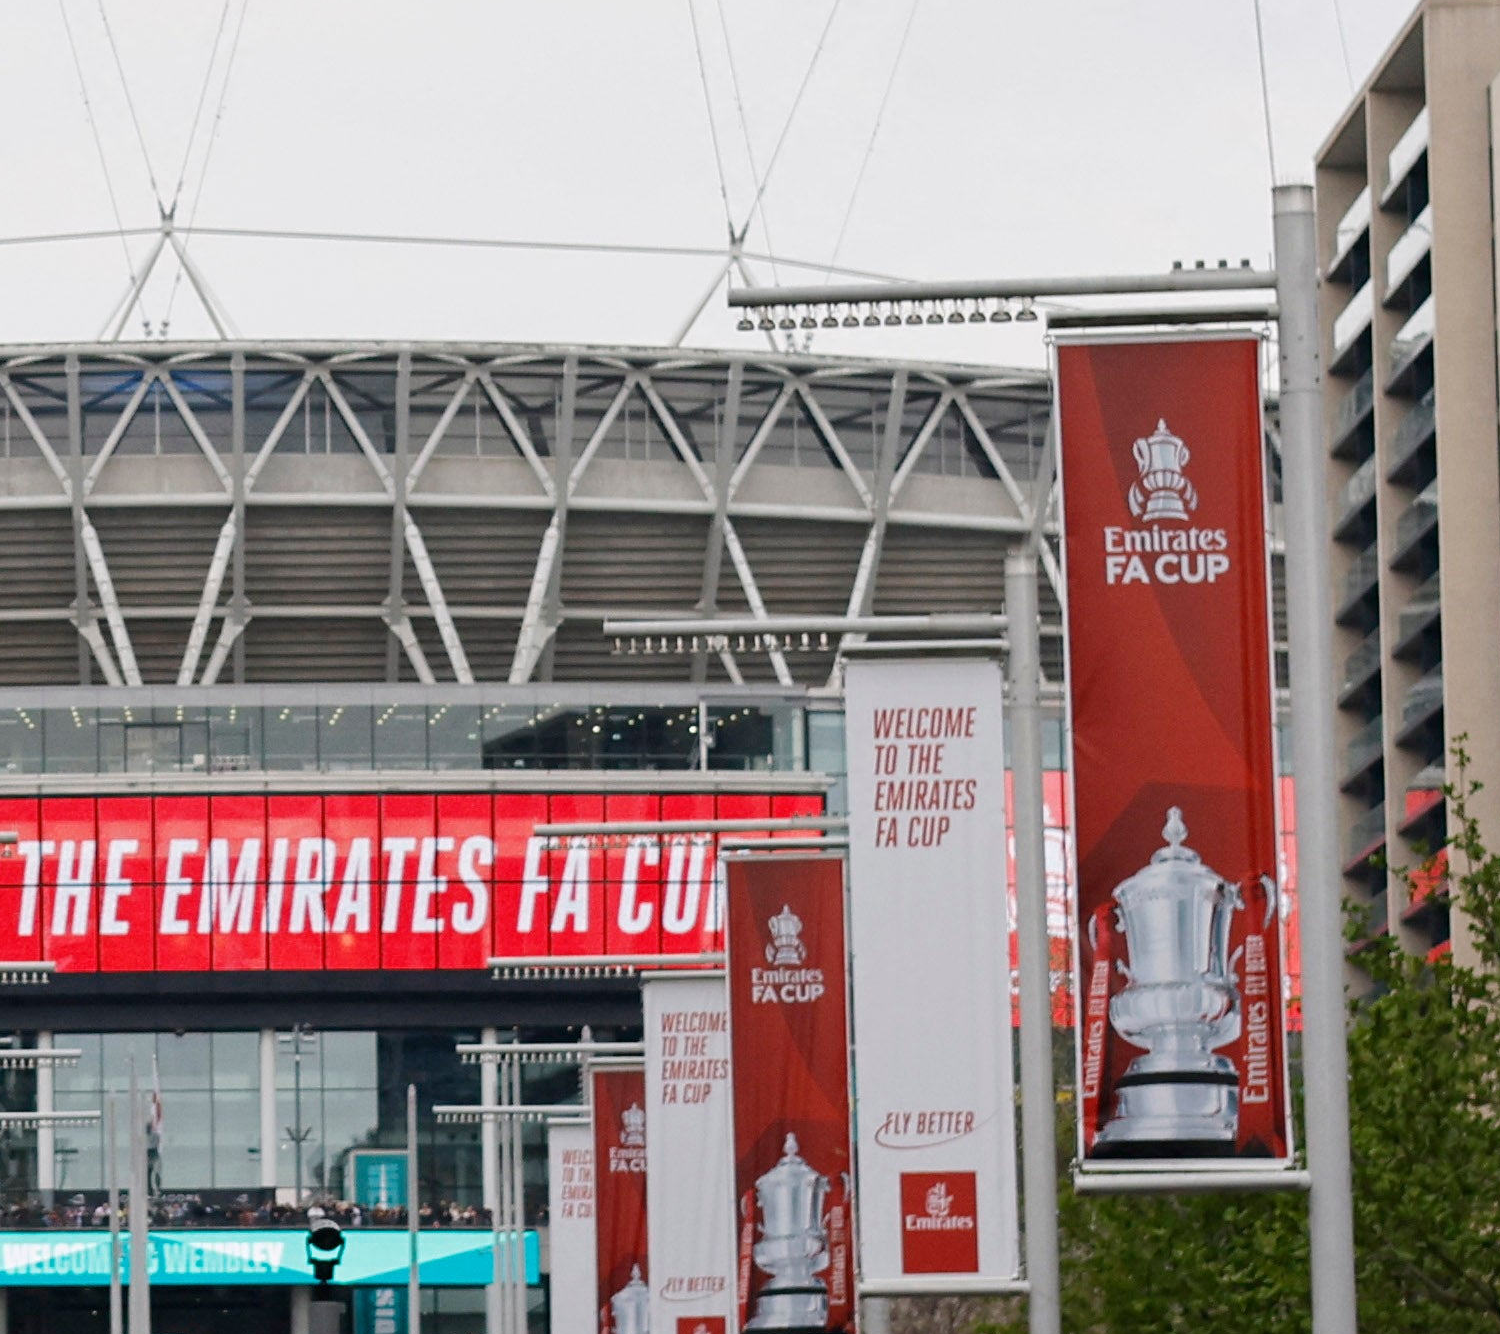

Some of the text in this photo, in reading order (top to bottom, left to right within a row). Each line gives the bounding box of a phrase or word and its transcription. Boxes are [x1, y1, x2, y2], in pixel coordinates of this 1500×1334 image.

[1104, 524, 1228, 553] Emirates
[1105, 553, 1231, 585] FA CUP
[873, 706, 977, 739] WELCOME
[874, 744, 945, 775] TO THE
[874, 779, 977, 811] EMIRATES
[875, 815, 950, 848] FA CUP
[17, 839, 139, 937] THE
[159, 836, 495, 935] EMIRATES
[516, 835, 592, 934] FA
[751, 967, 823, 984] Emirates
[752, 983, 825, 1004] FA CUP
[661, 1011, 728, 1033] WELCOME
[662, 1036, 708, 1056] TO THE
[1082, 1020, 1109, 1099] Emirates
[1242, 1001, 1270, 1105] Emirates
[661, 1059, 729, 1080] EMIRATES
[662, 1083, 712, 1104] FA CUP
[884, 1110, 975, 1135] FLY BETTER
[905, 1214, 973, 1231] Emirates
[164, 1242, 285, 1274] WEMBLEY
